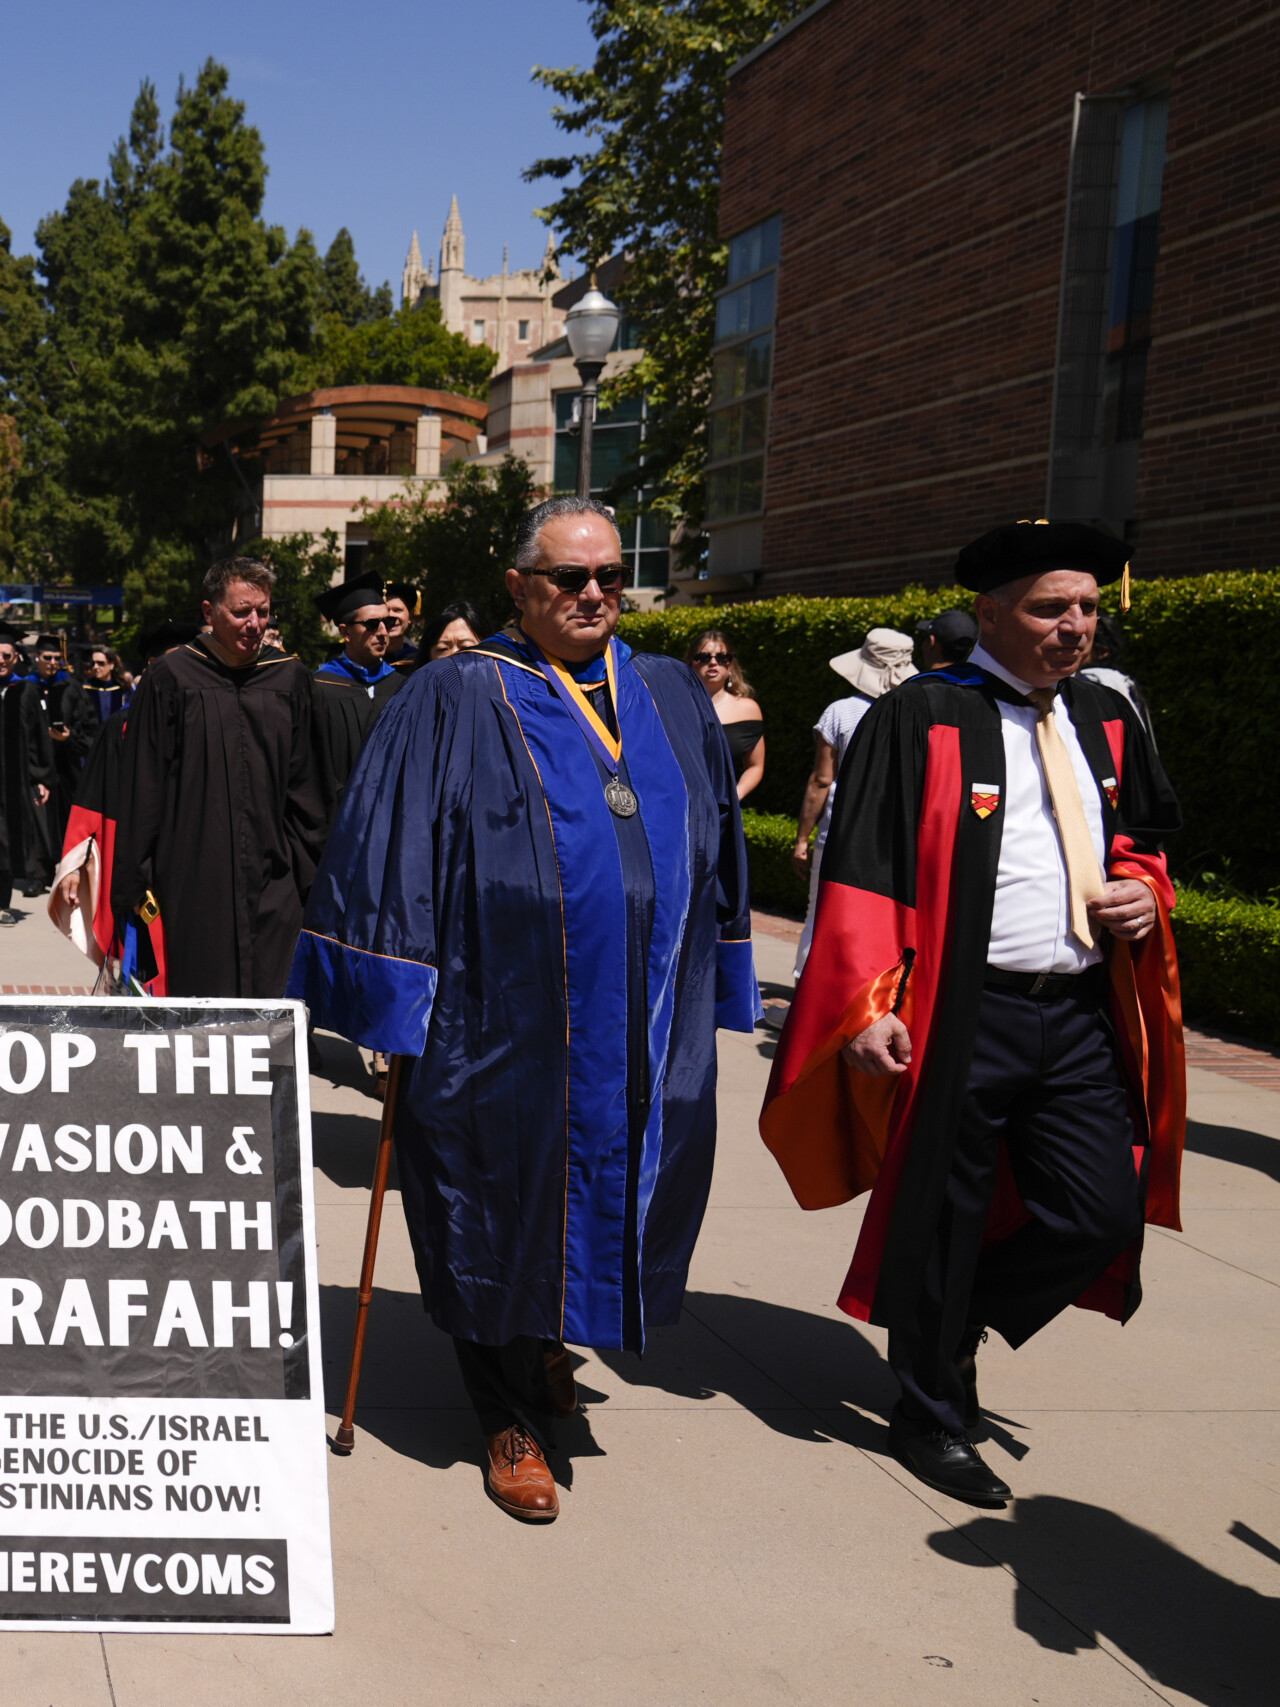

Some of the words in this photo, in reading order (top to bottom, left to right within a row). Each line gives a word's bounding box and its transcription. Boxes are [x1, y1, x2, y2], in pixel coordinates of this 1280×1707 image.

[122, 1033, 273, 1096] THE
[225, 1126, 263, 1175] &
[4, 1413, 66, 1440] THE
[79, 1414, 269, 1443] U.S./ISRAEL
[156, 1449, 198, 1477] OF
[165, 1484, 262, 1513] NOW!
